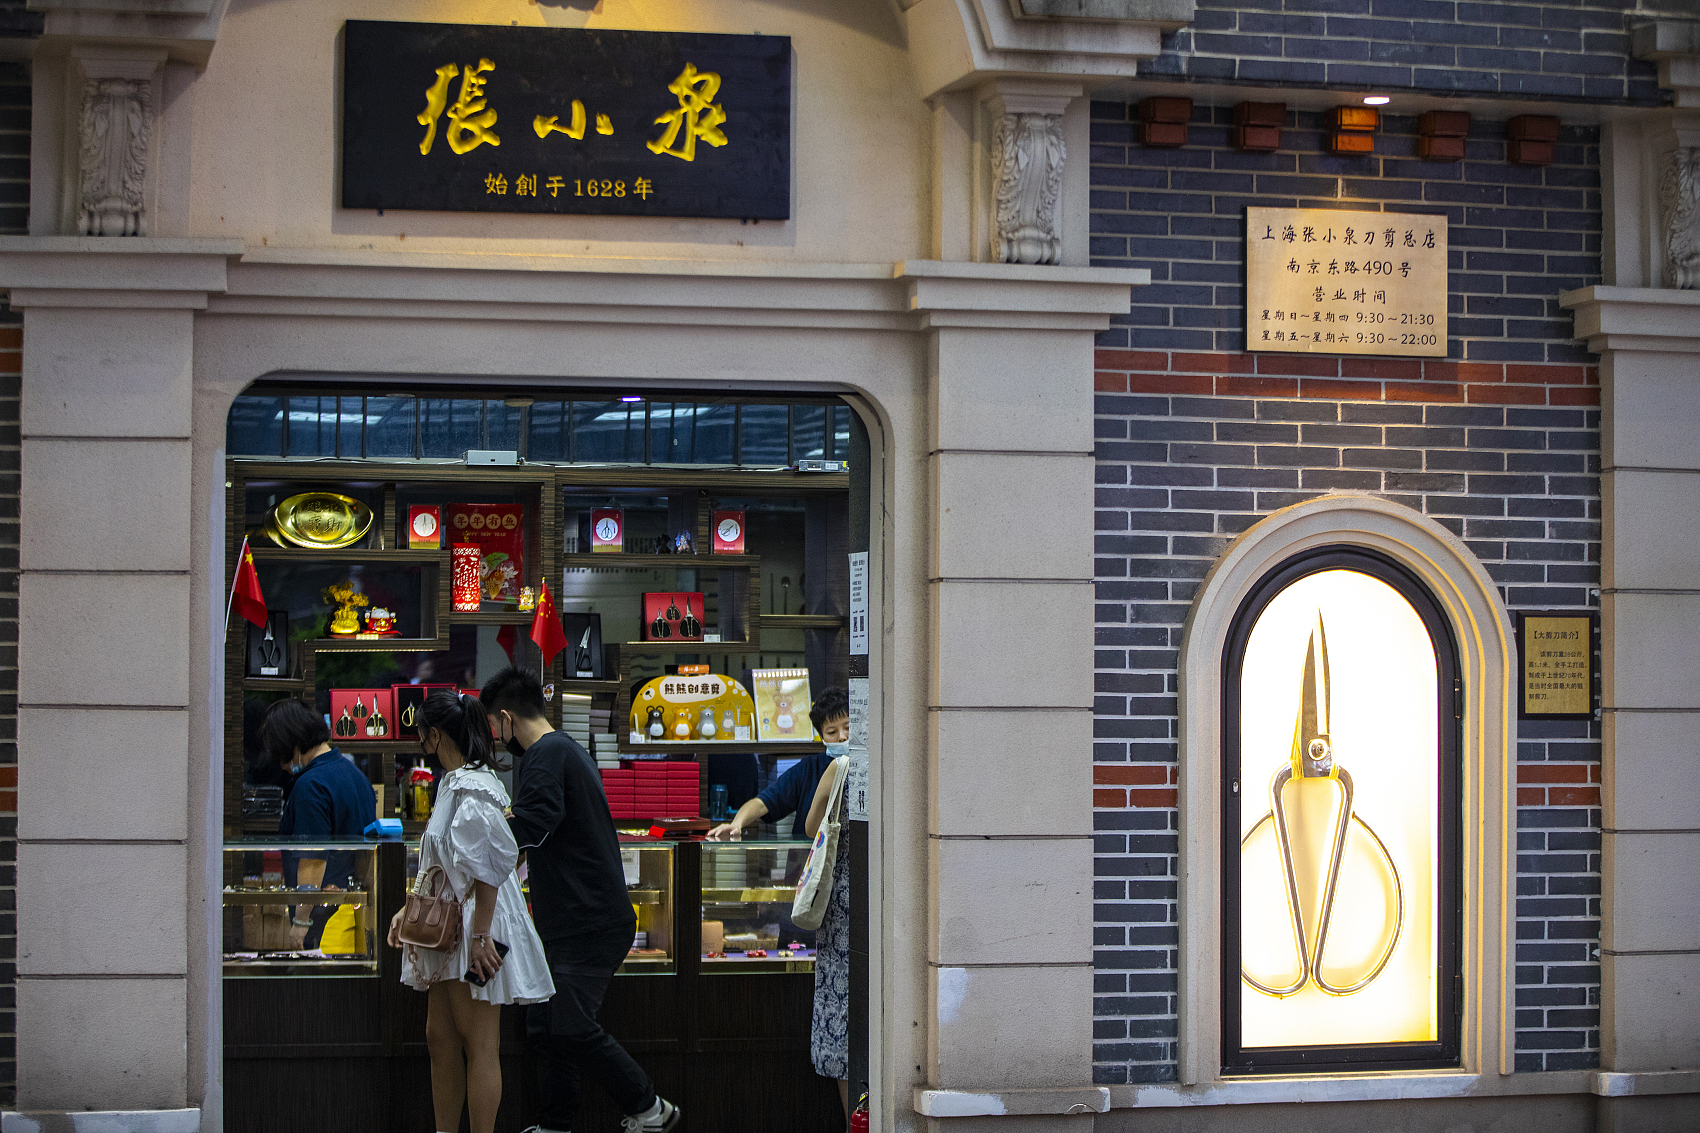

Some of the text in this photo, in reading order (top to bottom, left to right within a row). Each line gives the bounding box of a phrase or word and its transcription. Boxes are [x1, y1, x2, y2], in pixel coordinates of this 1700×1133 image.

[417, 57, 729, 162] 張小泉
[1261, 224, 1437, 249] 上海张小泉刀剪总店
[1286, 257, 1412, 278] 南京东路490号
[1312, 286, 1387, 305] 营业时间
[455, 515, 516, 528] 年年有鱼
[664, 683, 720, 695] 熊熊创意剪
